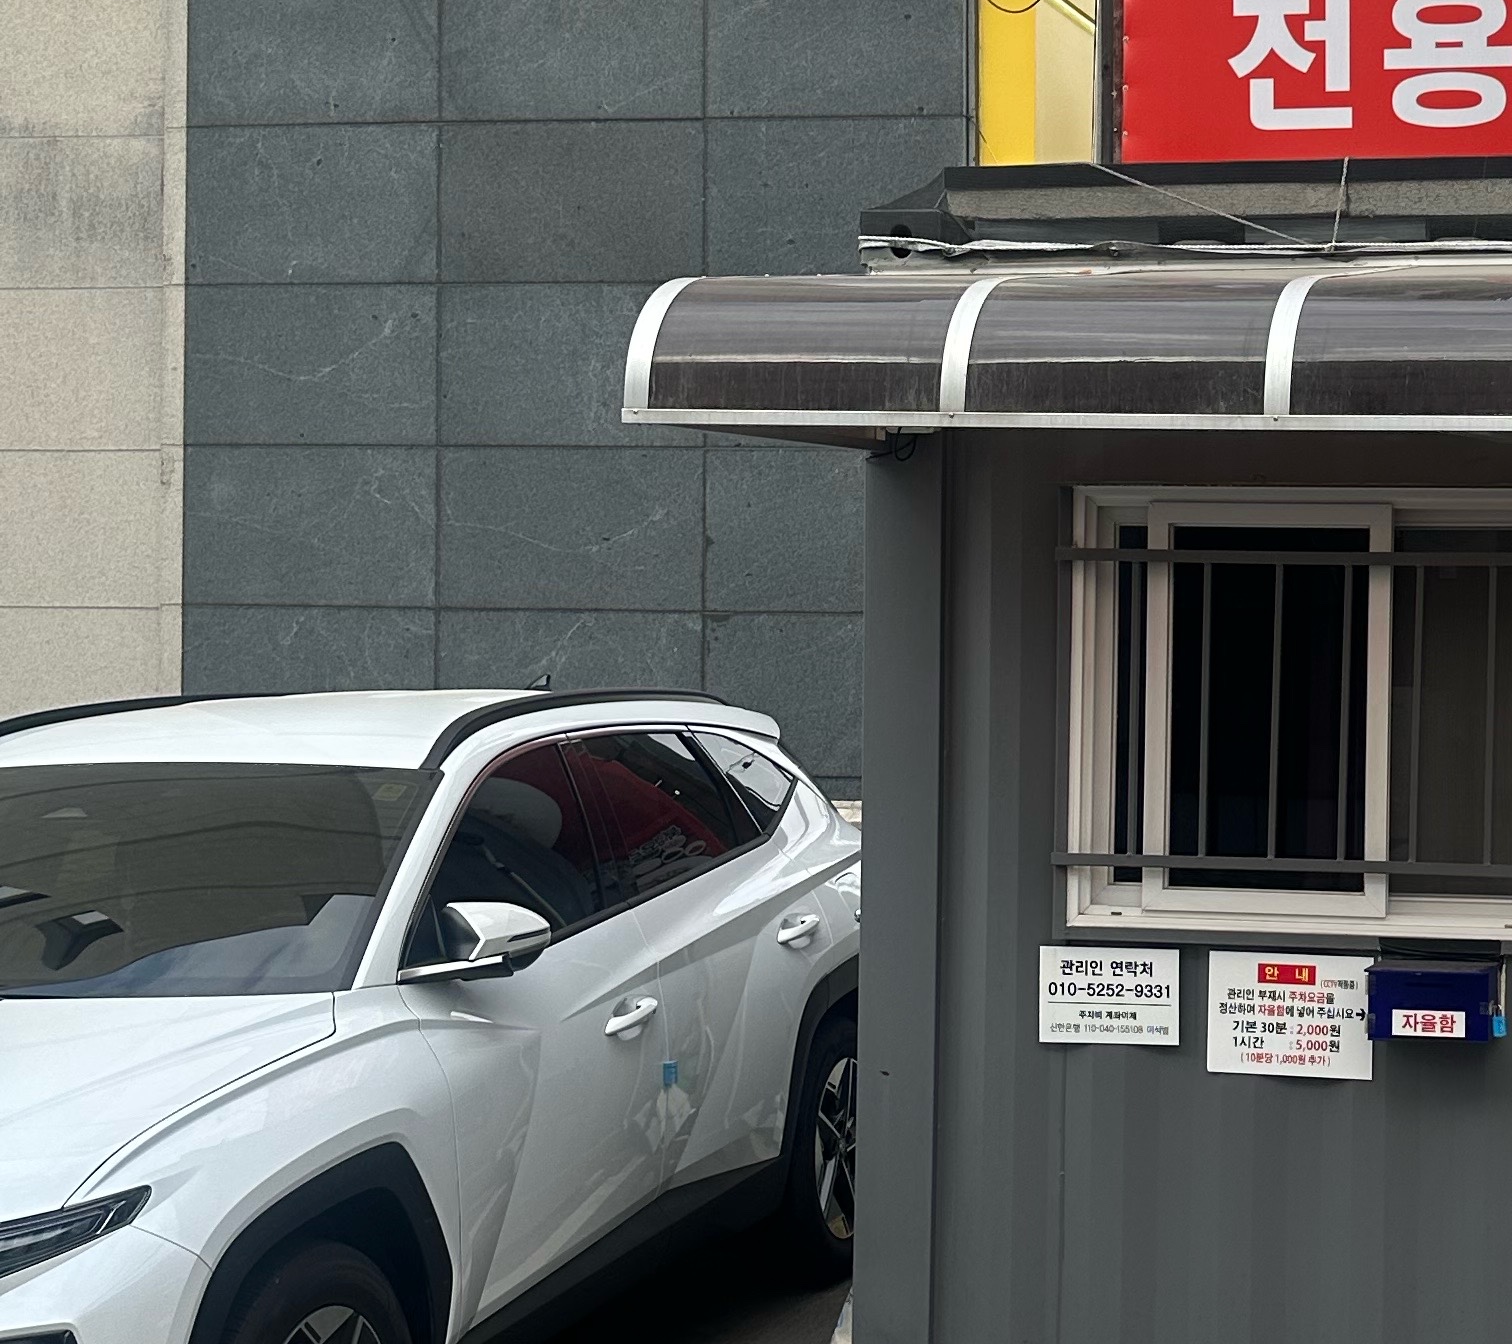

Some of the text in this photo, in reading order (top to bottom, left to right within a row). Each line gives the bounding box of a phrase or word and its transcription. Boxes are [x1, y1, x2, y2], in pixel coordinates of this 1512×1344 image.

[1060, 959, 1153, 977] 관리인 연락처
[1048, 981, 1170, 998] 010-5252-9331
[1227, 988, 1335, 1004] 관리인 부재시 주차요금을
[1232, 1020, 1257, 1034] 기본
[1260, 1022, 1287, 1035] 30분
[1296, 1023, 1341, 1038] 2,000원
[1402, 1013, 1456, 1034] 자율함
[1233, 1036, 1265, 1049] 1시간
[1296, 1039, 1340, 1053] 5,000원
